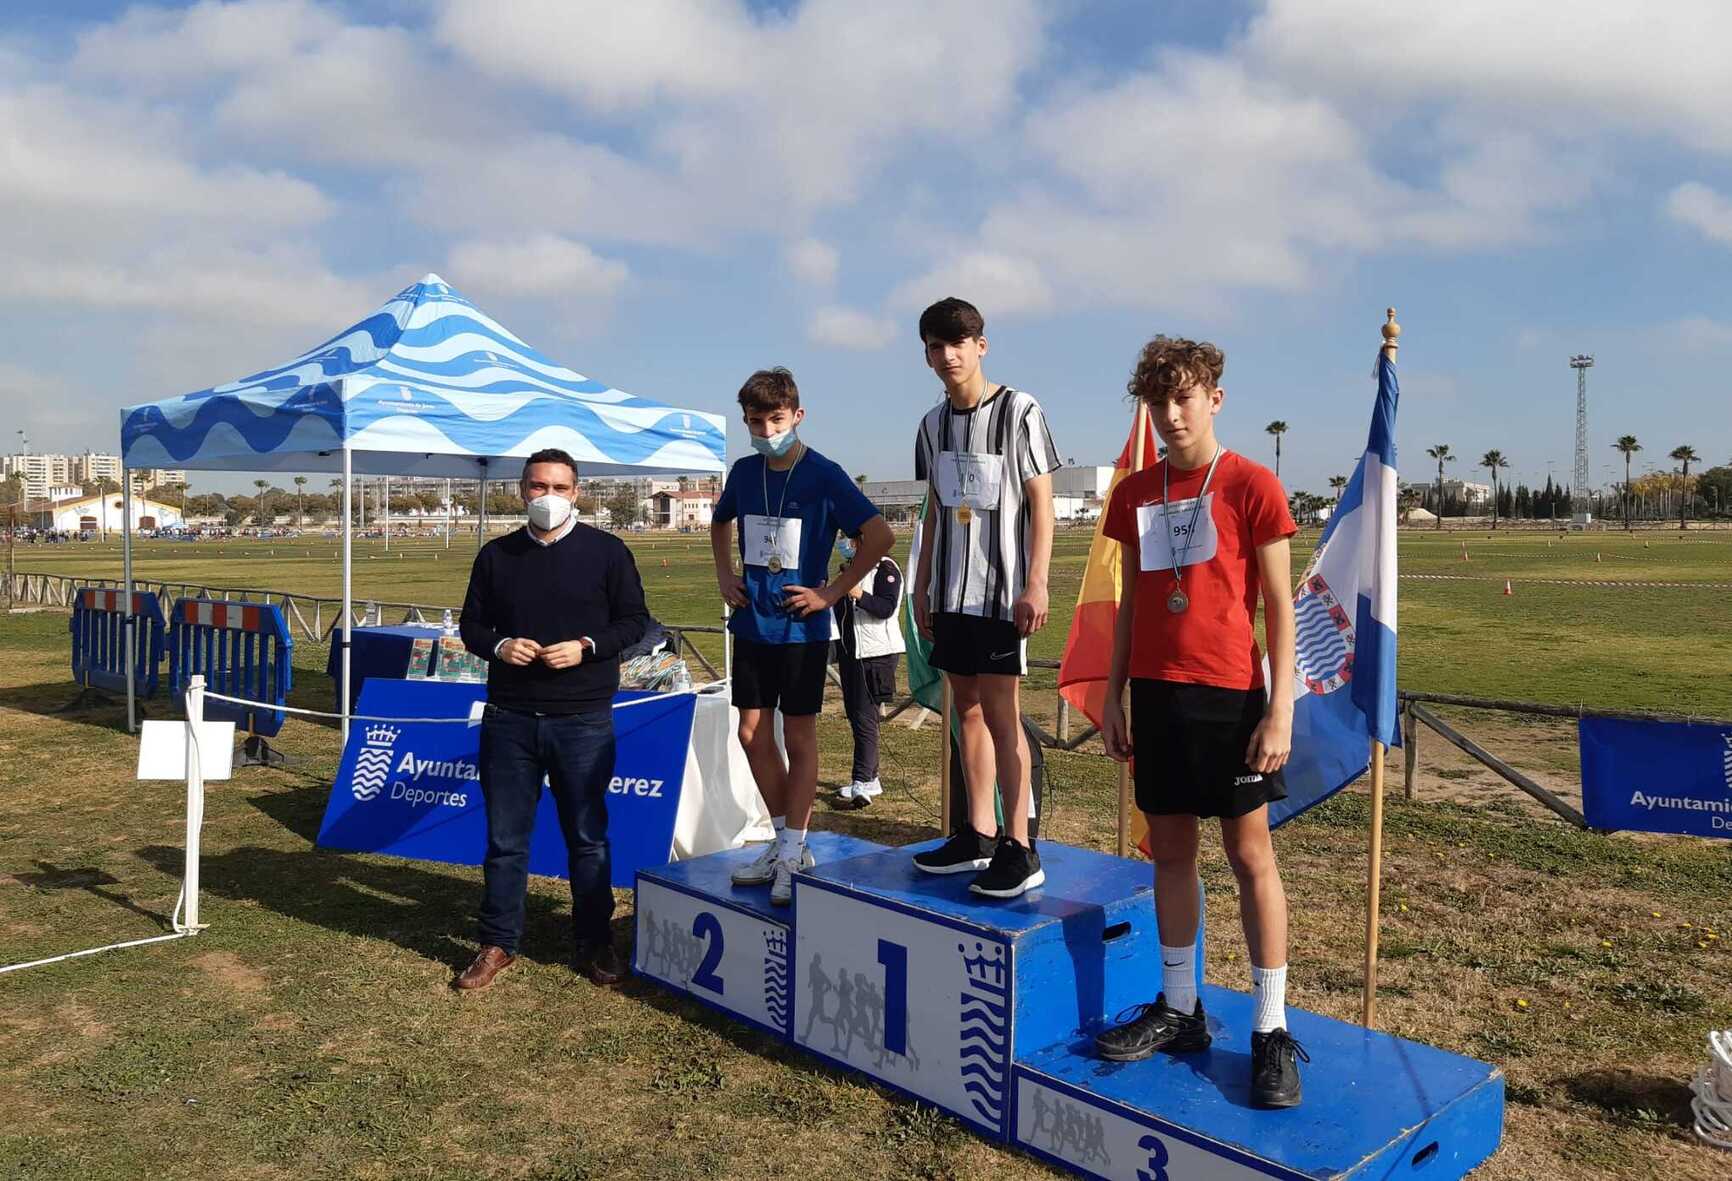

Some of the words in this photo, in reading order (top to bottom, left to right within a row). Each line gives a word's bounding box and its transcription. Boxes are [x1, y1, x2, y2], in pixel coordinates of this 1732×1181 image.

[391, 781, 468, 808] Deportes
[396, 752, 480, 781] Ayunta
[607, 776, 665, 798] erez
[1629, 790, 1732, 813] Ayuntami
[692, 911, 725, 995] 2
[876, 938, 908, 1056] 1
[1136, 1134, 1170, 1181] 3
